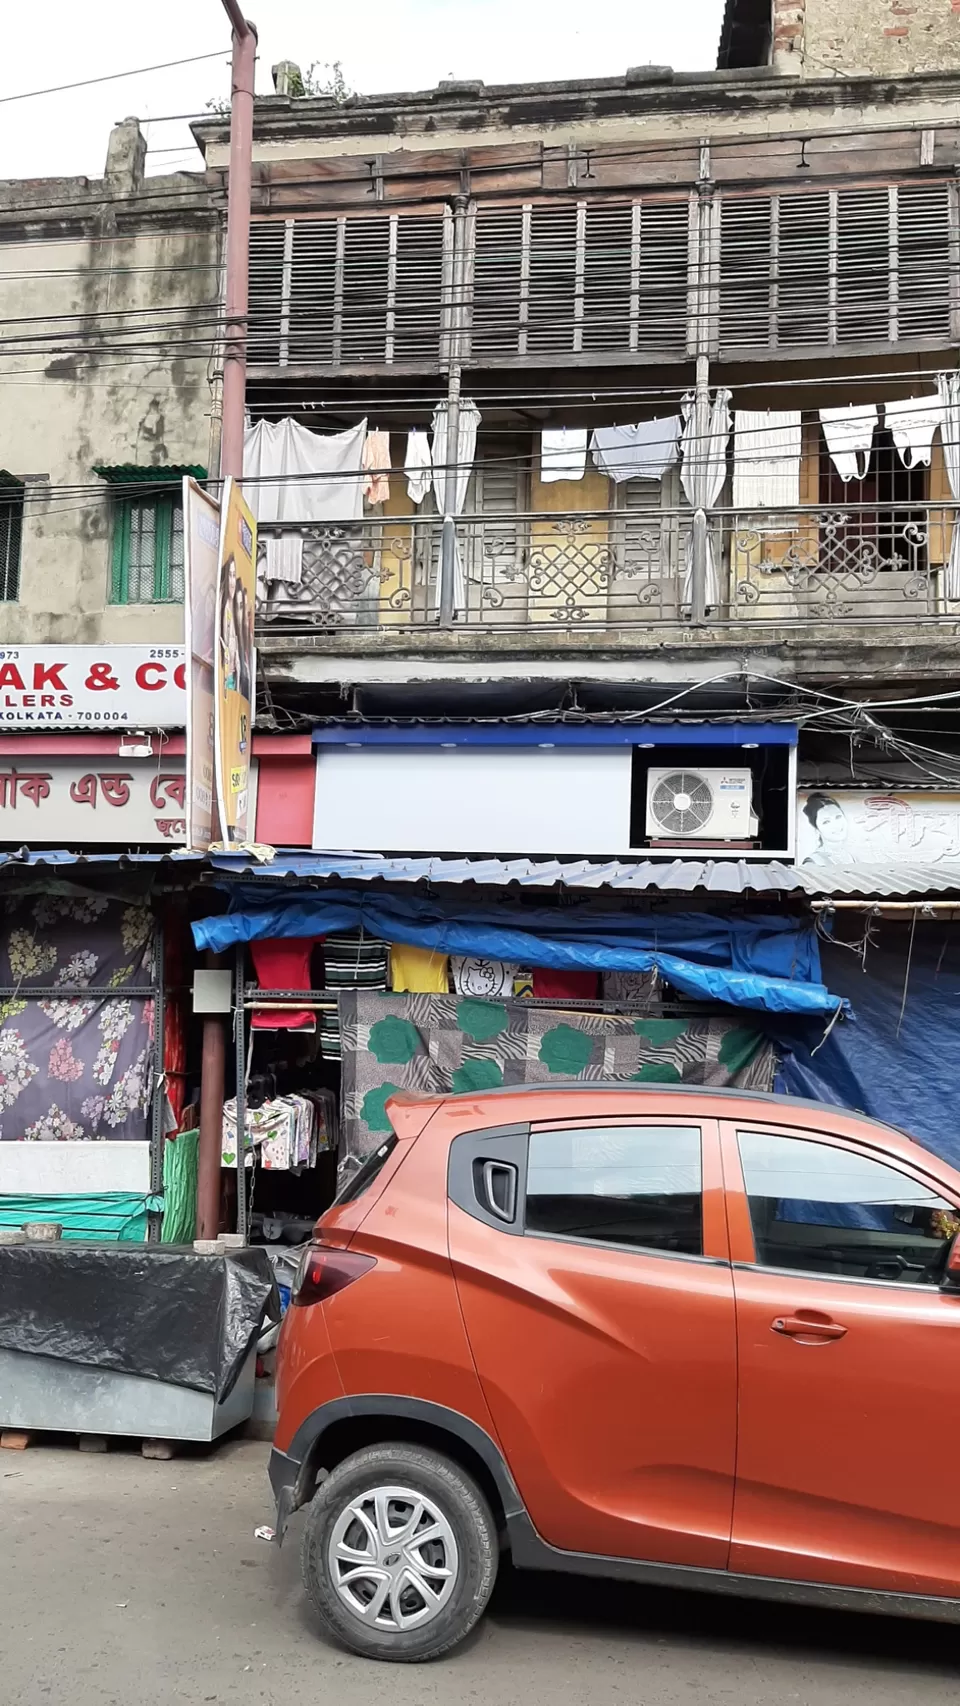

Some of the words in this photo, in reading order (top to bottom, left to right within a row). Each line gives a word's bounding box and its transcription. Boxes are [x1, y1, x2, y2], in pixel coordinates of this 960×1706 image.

[85, 662, 120, 692] &
[5, 694, 74, 707] LERS
[77, 712, 128, 721] 700004
